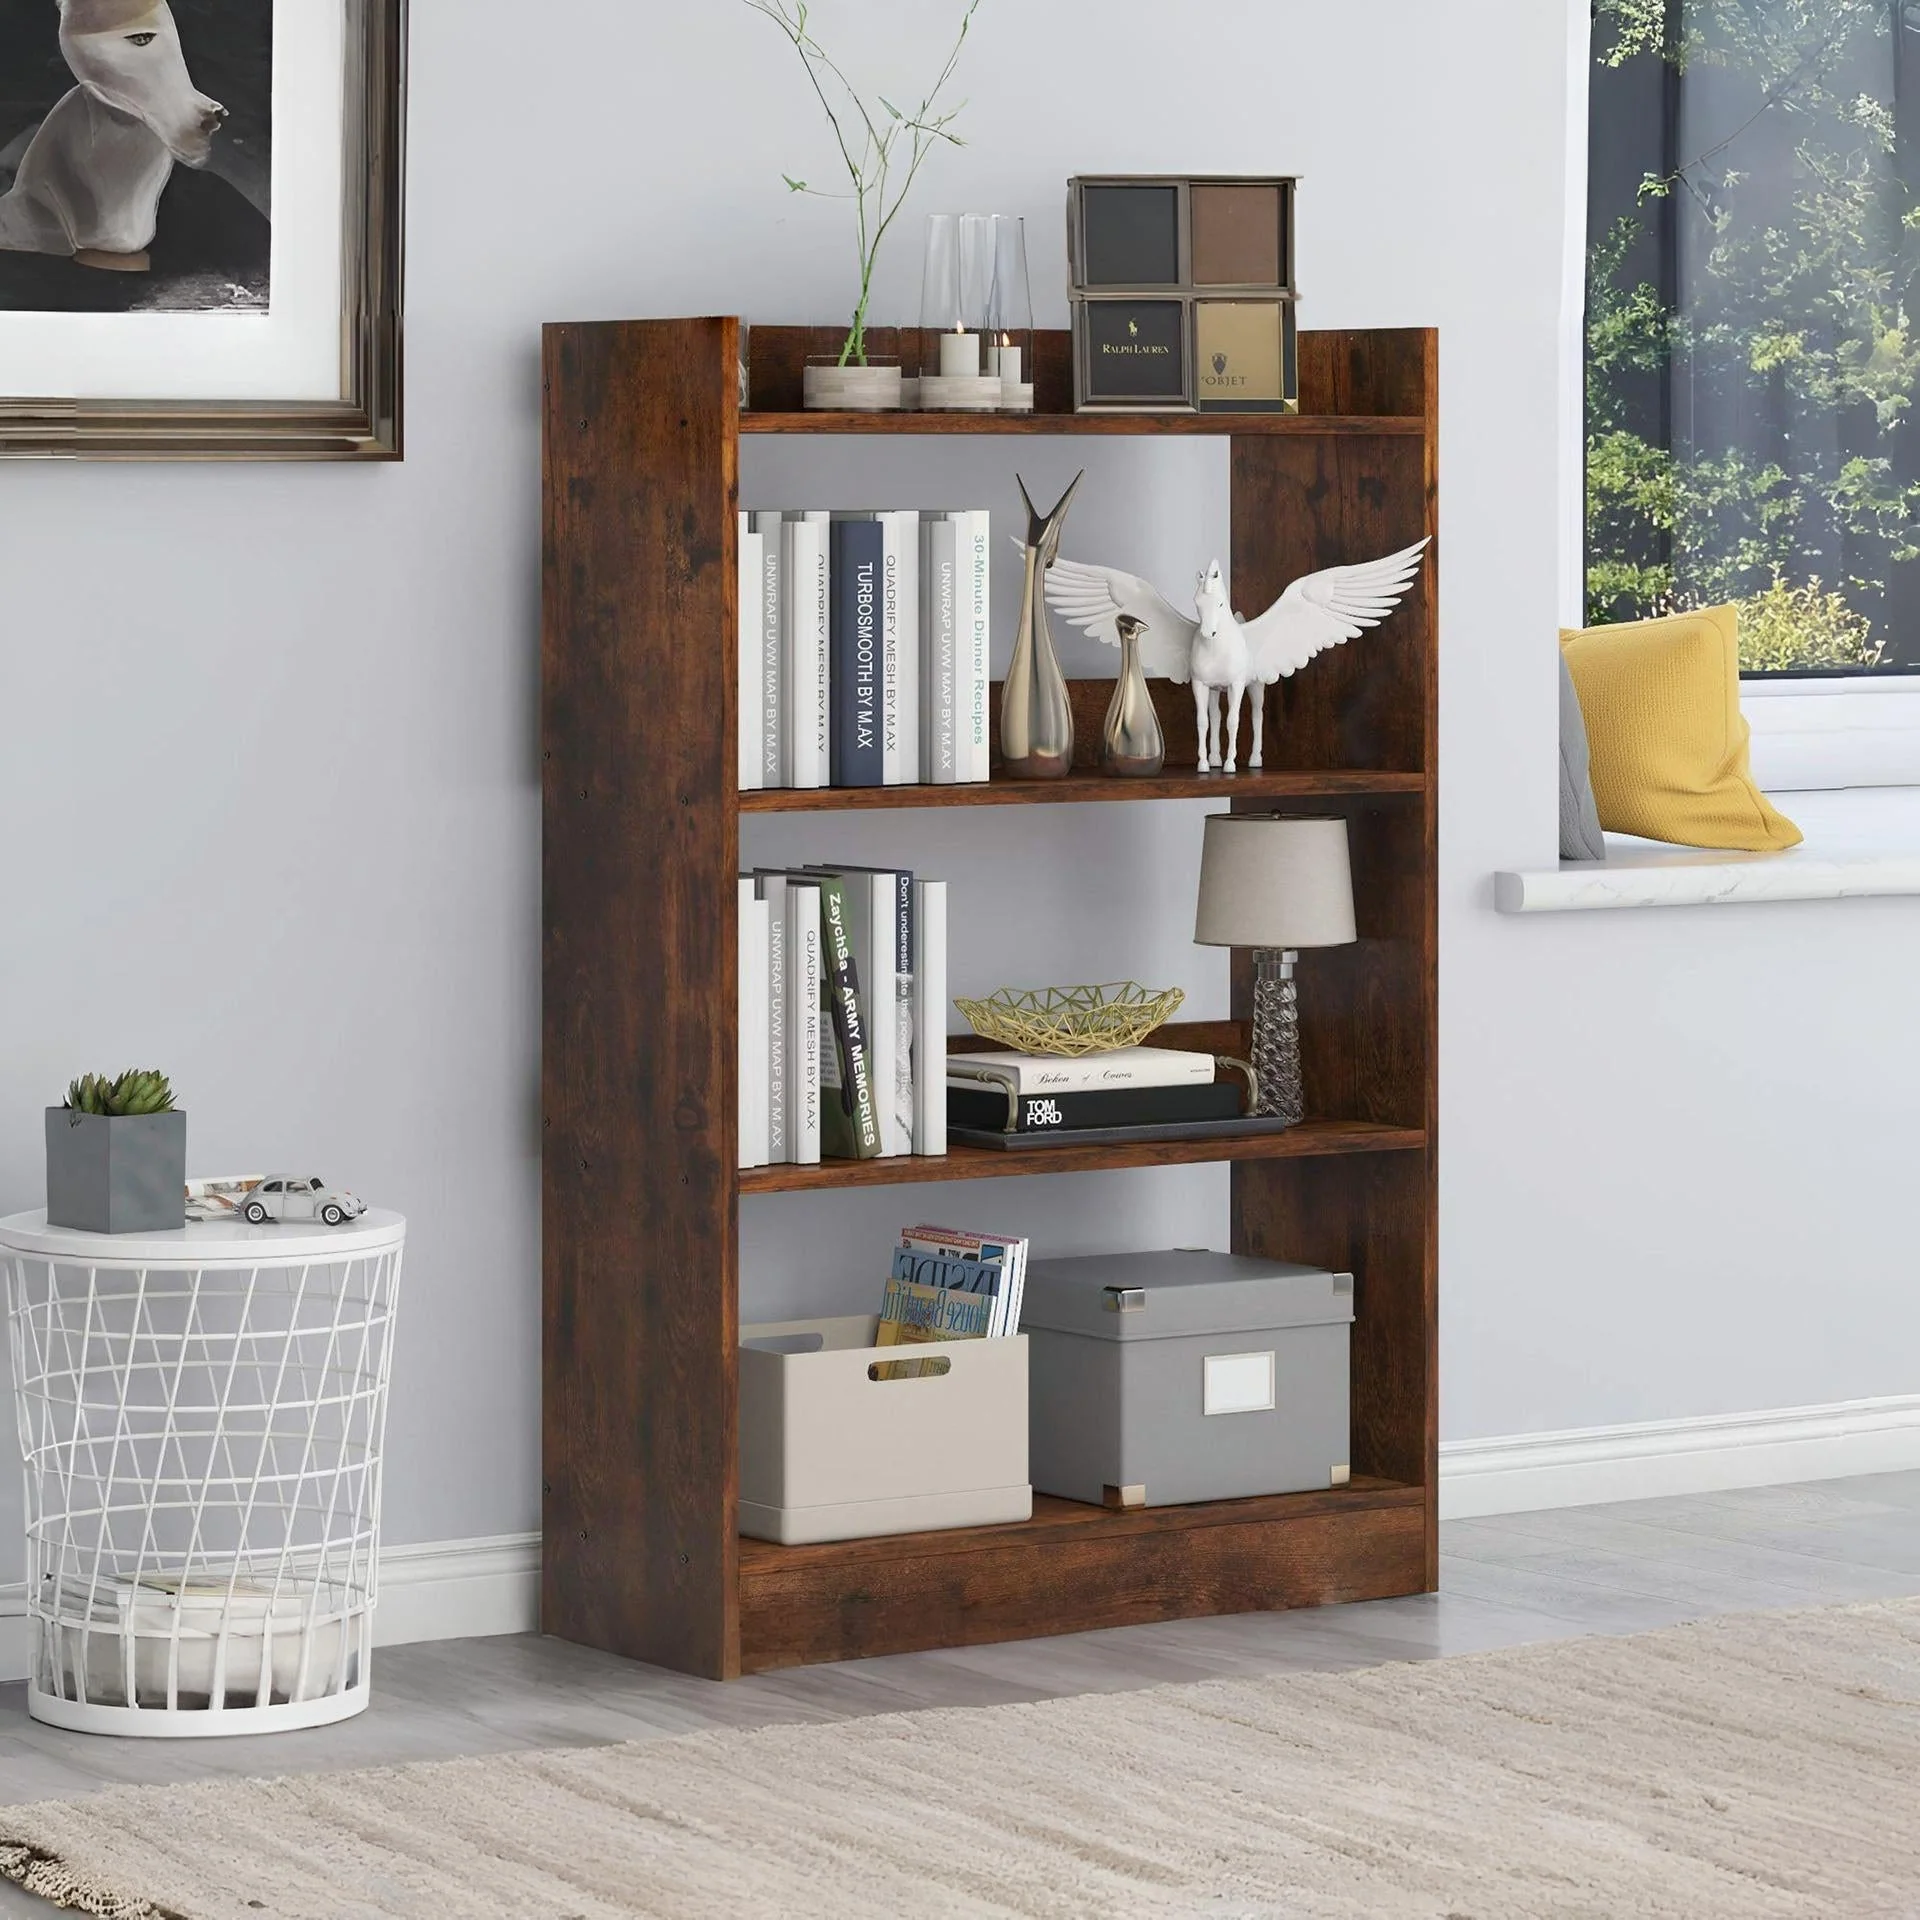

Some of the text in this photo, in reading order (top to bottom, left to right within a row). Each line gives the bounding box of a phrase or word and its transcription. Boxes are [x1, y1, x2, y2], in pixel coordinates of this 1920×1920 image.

[766, 554, 777, 625] UNWRAP
[886, 555, 896, 636] QUADRIFY
[941, 562, 952, 629] UNWRAP
[766, 629, 777, 666] UVW
[857, 562, 873, 749] TURBOSMOOTH BY M.AX
[941, 633, 952, 668] UVW
[971, 534, 985, 745] 30-Minute Dinner Recipes
[886, 640, 896, 684] MESH
[766, 670, 777, 704] MAP
[886, 689, 896, 710] BY
[941, 672, 952, 704] MAP
[766, 708, 777, 729] BY
[941, 708, 952, 729] BY
[900, 876, 910, 908] Don't
[829, 892, 848, 972] ZaychSa
[771, 921, 782, 994] UNWRAP
[806, 930, 816, 1012] QUADRIFY
[771, 998, 782, 1036] UVW
[842, 986, 861, 1040] ARMY
[806, 1016, 816, 1061] MESH
[771, 1041, 782, 1077] MAP
[806, 1066, 816, 1087] BY
[771, 1082, 782, 1103] BY
[850, 1043, 875, 1147] MEMORIES
[1026, 1100, 1056, 1114] TOM
[1026, 1111, 1062, 1126] FORD
